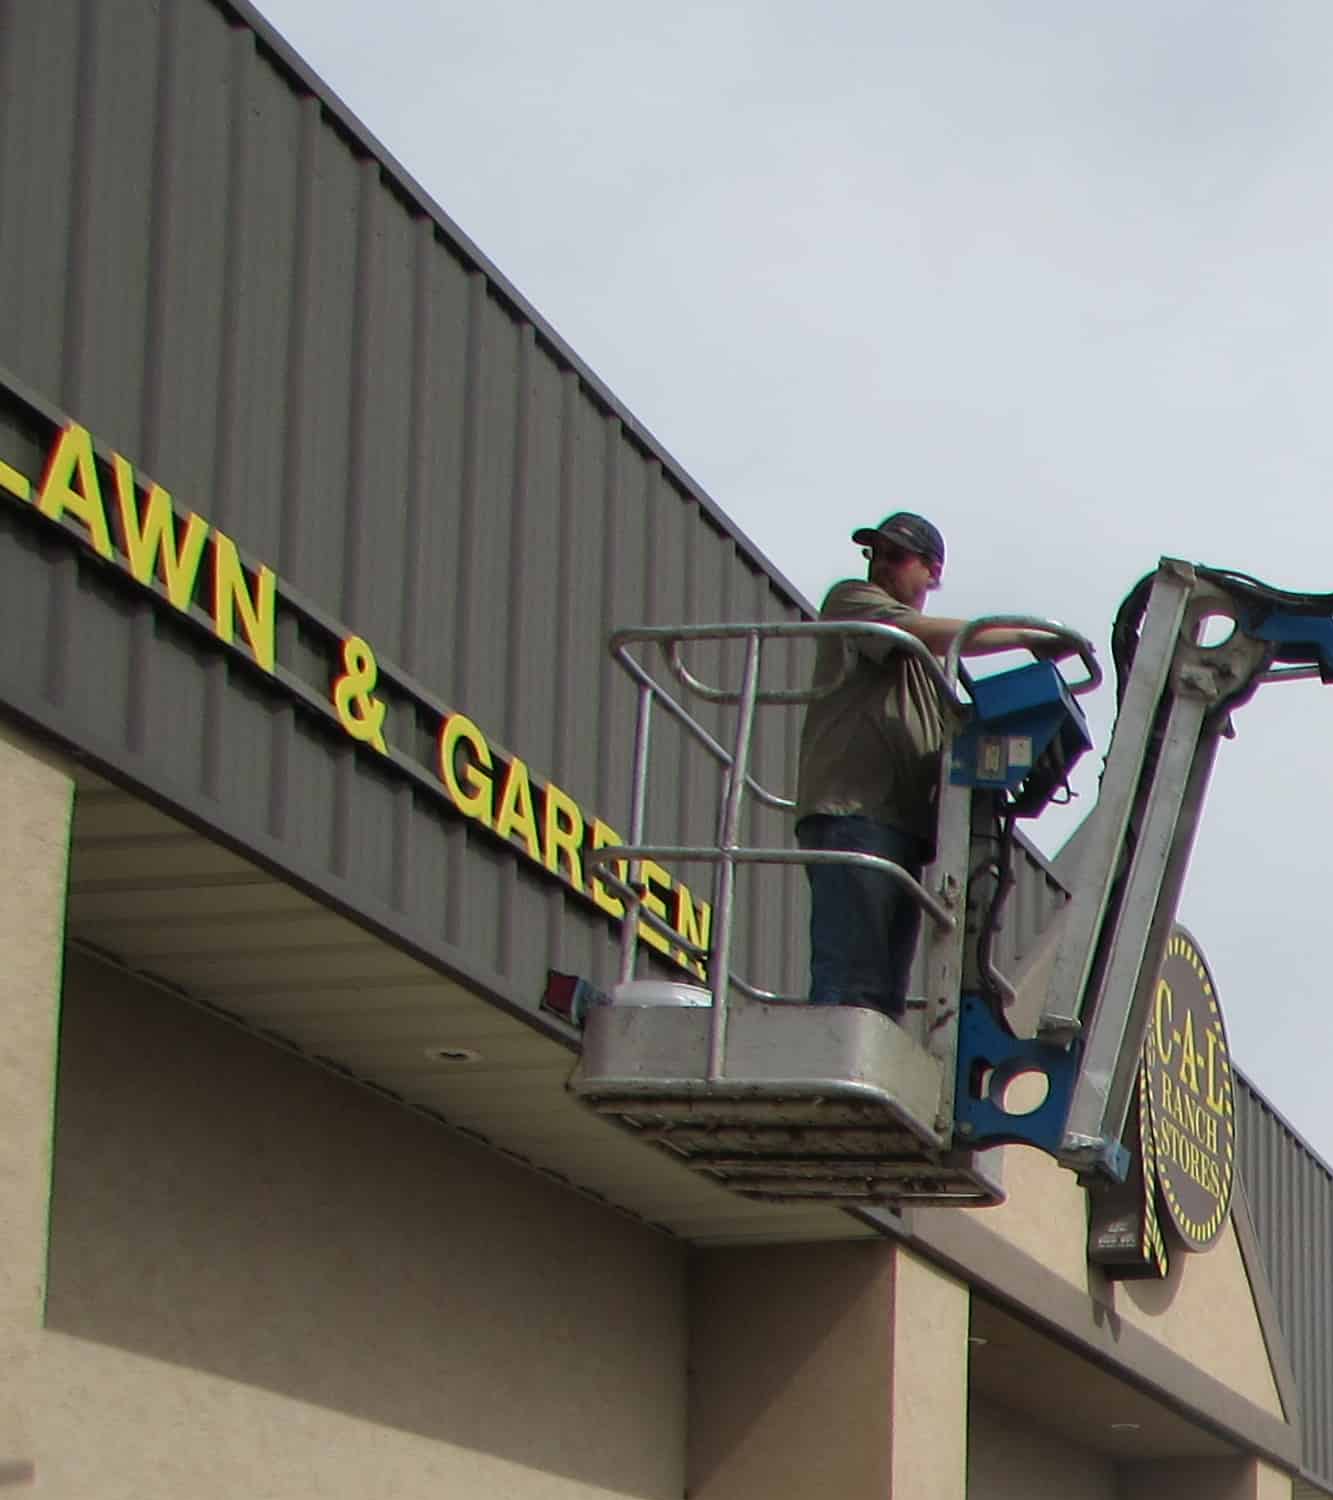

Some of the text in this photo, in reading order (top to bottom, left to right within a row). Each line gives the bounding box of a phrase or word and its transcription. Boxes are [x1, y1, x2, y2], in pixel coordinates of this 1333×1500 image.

[0, 420, 277, 673] AWN
[334, 636, 390, 754] &
[1161, 1071, 1217, 1154] RANCH
[1160, 1116, 1220, 1199] STORES
